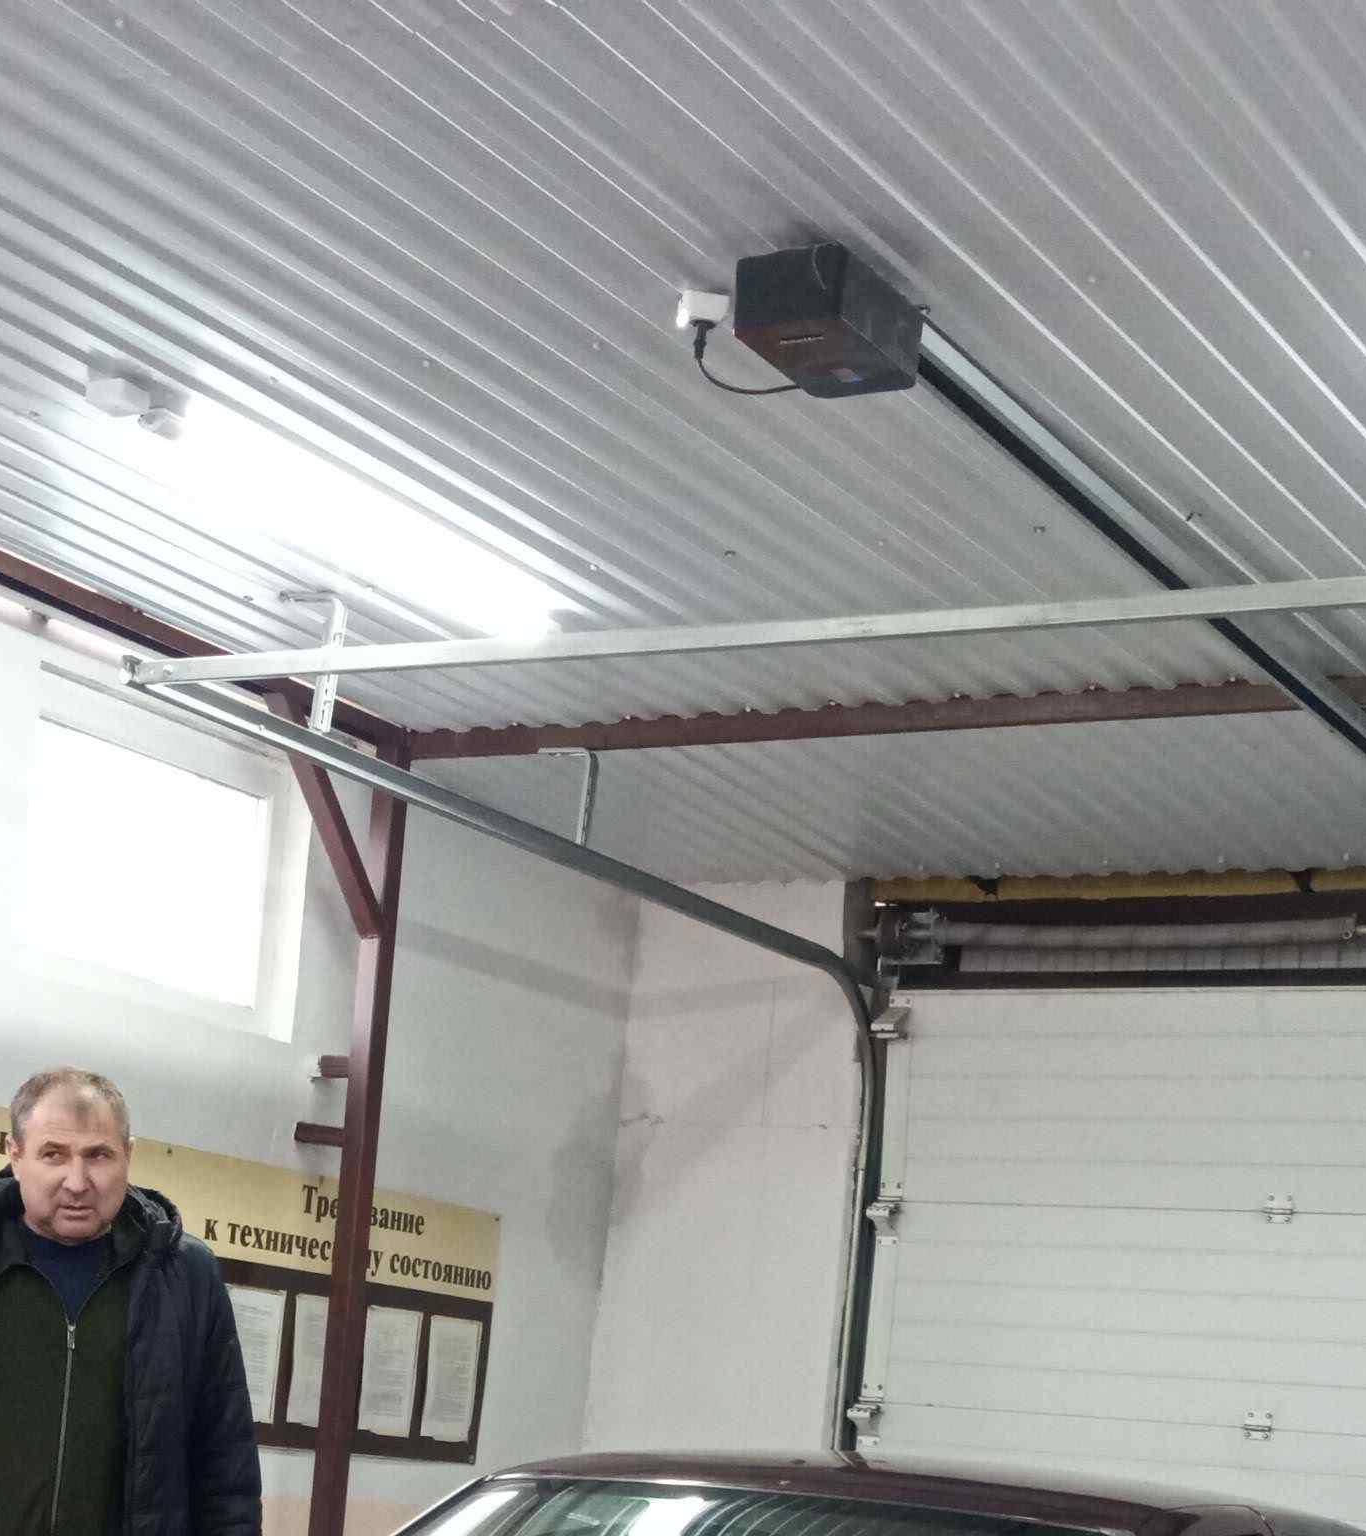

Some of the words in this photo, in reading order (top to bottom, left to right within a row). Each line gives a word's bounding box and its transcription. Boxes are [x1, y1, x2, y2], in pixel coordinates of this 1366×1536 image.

[302, 1184, 425, 1236] Тревание
[204, 1218, 218, 1242] к
[227, 1221, 384, 1277] техничесу
[389, 1253, 492, 1291] состоянию
